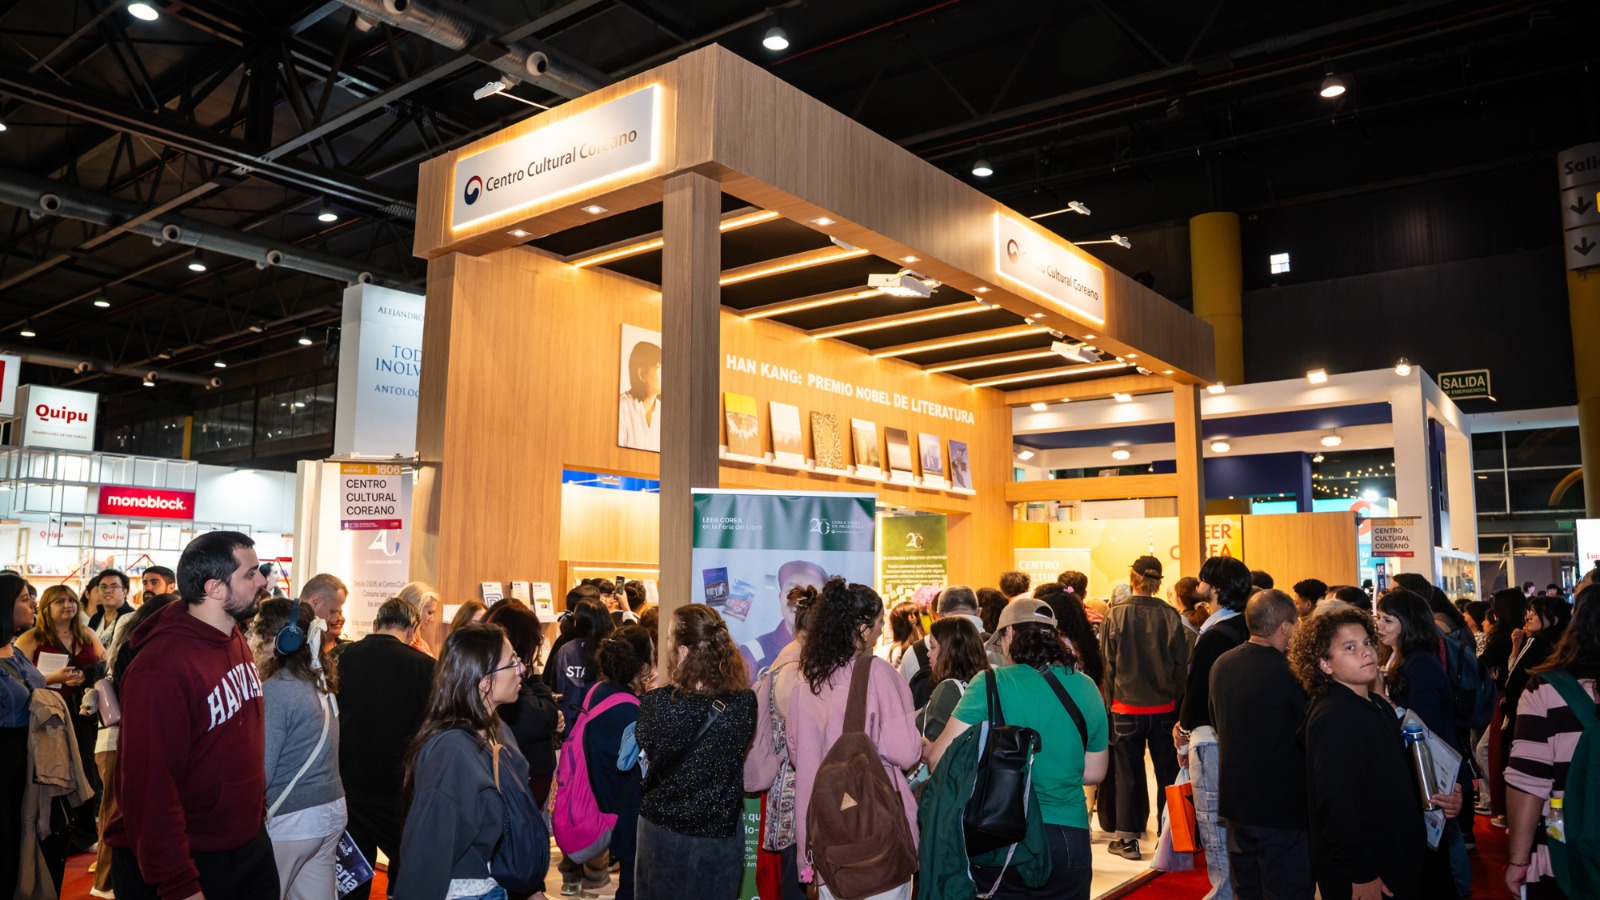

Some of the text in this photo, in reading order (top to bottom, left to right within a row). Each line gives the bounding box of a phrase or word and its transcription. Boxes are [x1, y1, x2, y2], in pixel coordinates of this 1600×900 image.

[486, 129, 638, 192] Centro Cultural Coreano
[1046, 265, 1073, 287] Cultural
[1073, 279, 1099, 301] Coreano
[726, 353, 975, 425] HAN KANG: PREMIO NOBEL DE LITERATURA
[1442, 375, 1486, 390] SALIDA
[35, 403, 88, 424] Quipu
[375, 464, 401, 475] 1606
[346, 479, 387, 489] CENTRO
[346, 492, 397, 502] CULTURAL
[346, 505, 395, 516] COREANO
[810, 517, 830, 535] 20
[1205, 523, 1232, 540] EER
[1018, 560, 1060, 571] CENTRO
[335, 857, 359, 892] eria
